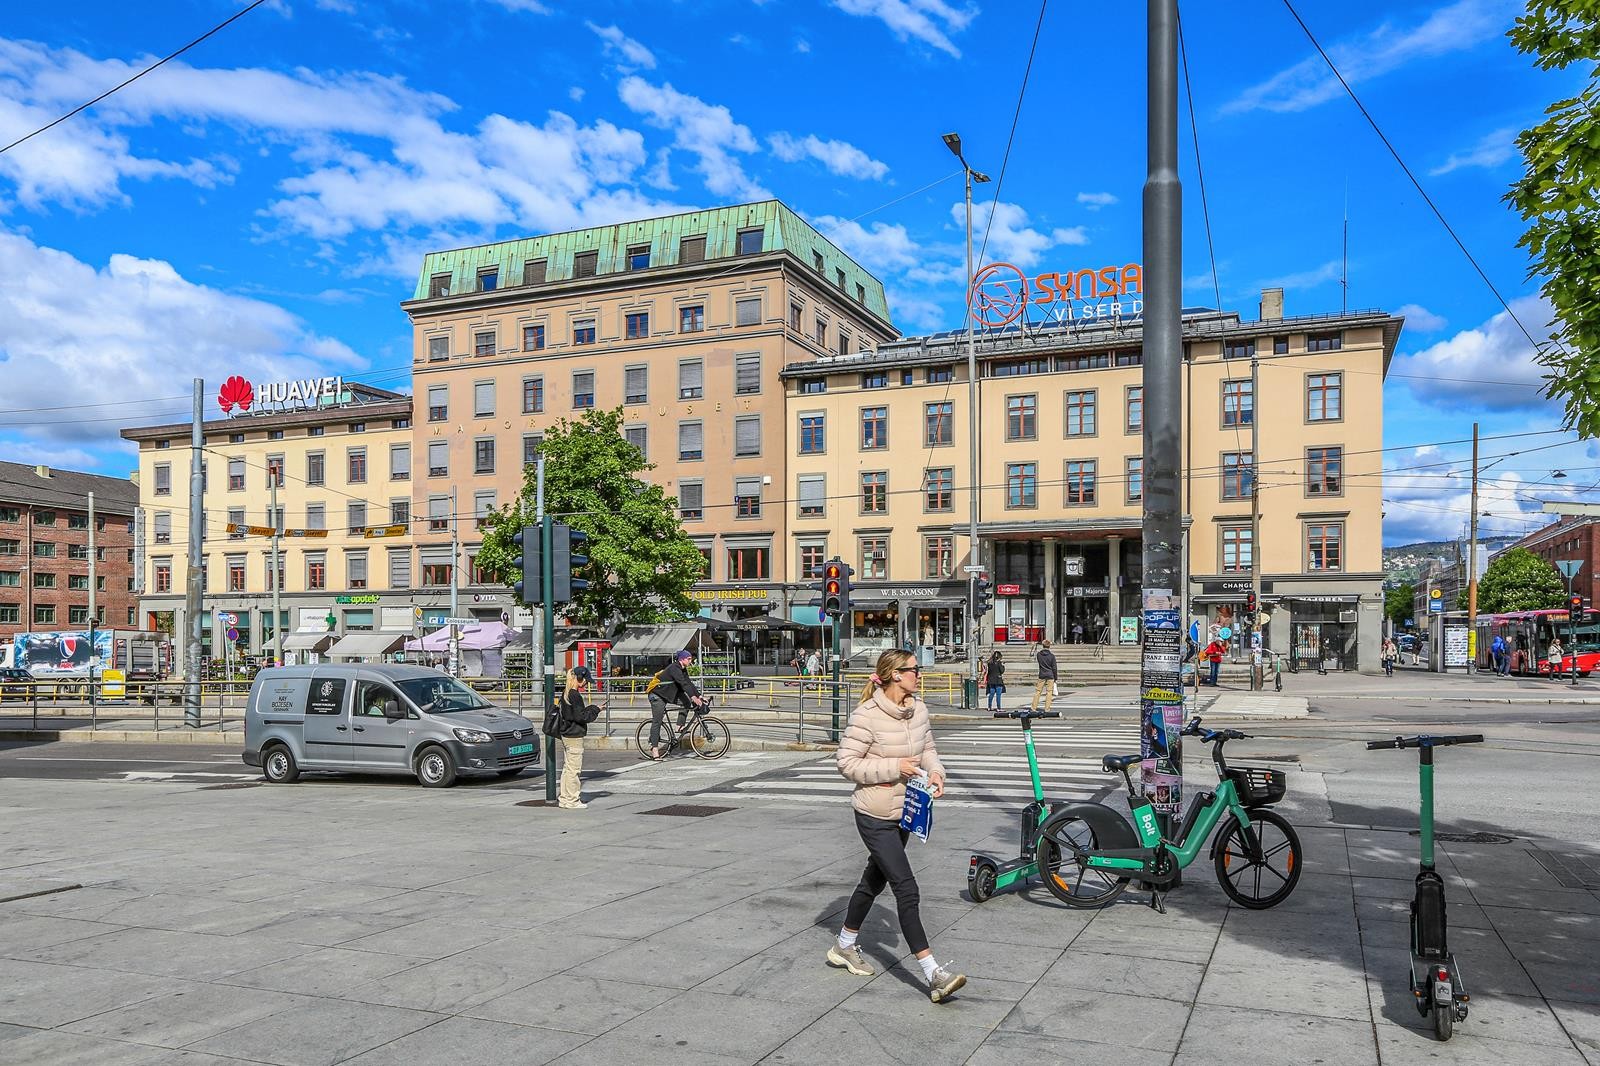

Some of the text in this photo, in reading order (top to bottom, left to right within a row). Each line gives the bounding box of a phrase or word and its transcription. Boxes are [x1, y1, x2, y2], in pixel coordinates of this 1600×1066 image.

[1035, 263, 1143, 304] SYNSA
[1055, 300, 1143, 321] VI SER D
[257, 376, 342, 403] HUAWEI
[694, 590, 715, 599] OLD
[718, 590, 745, 599] IRISH
[748, 590, 767, 599] PUB
[899, 588, 934, 596] SAMSON
[1142, 813, 1156, 836] Bolt
